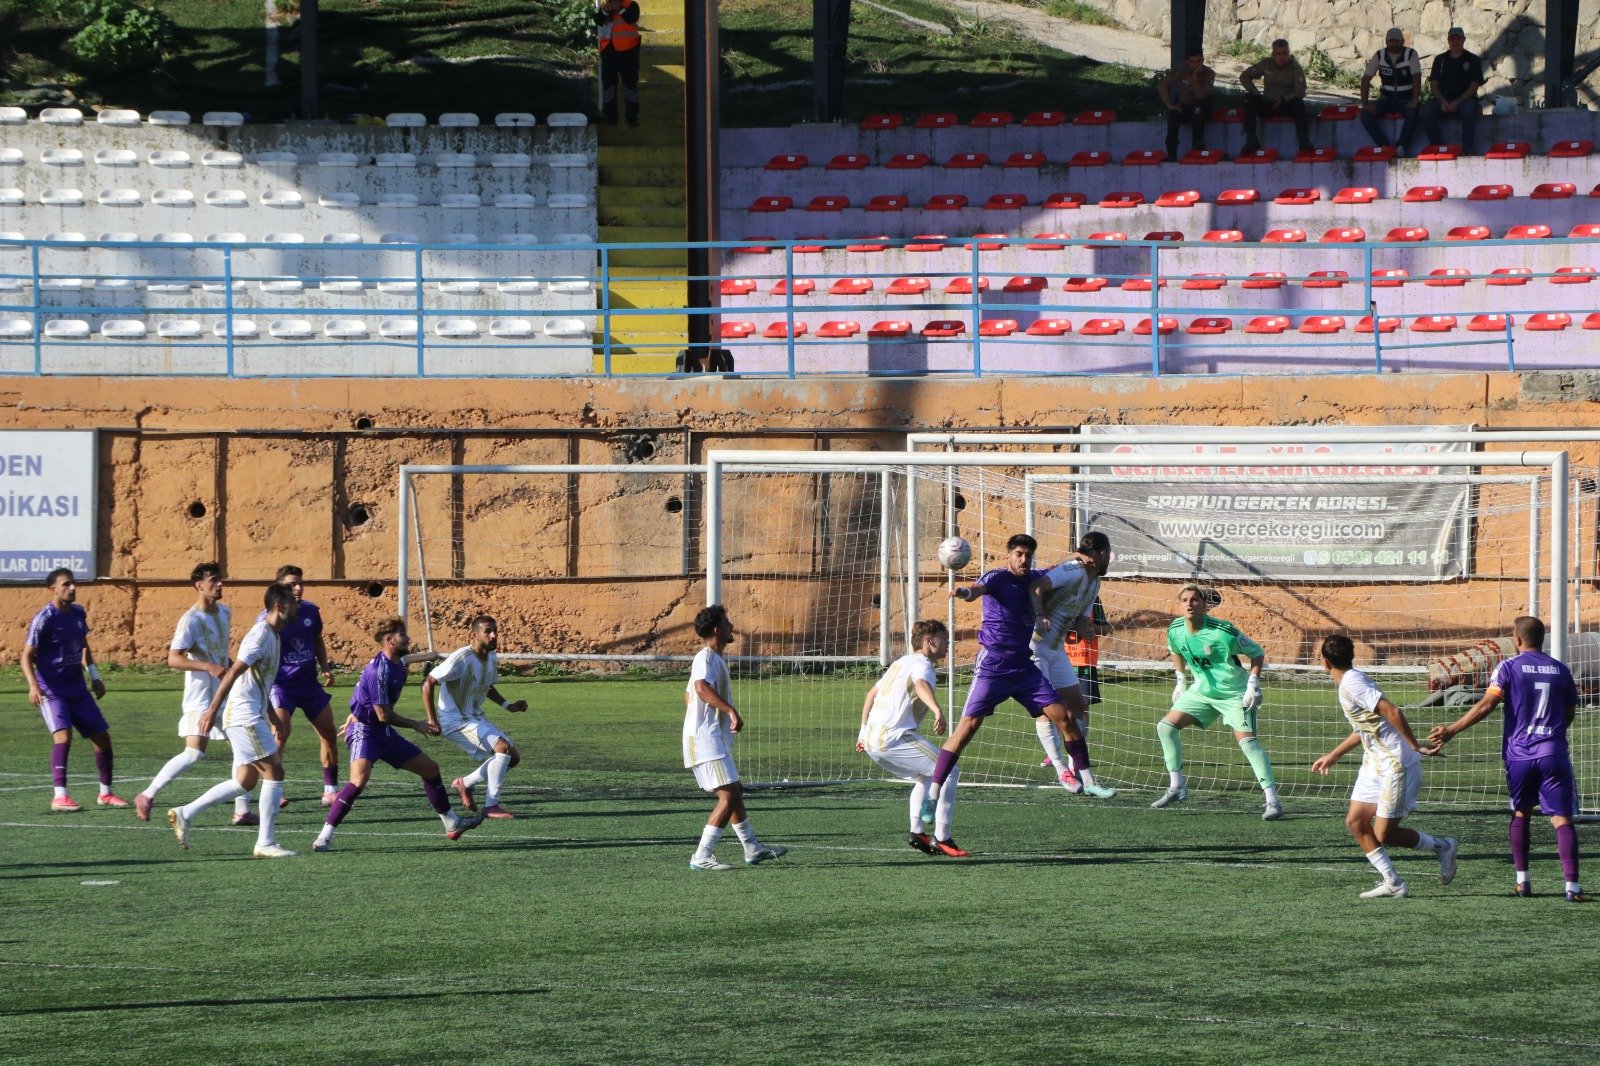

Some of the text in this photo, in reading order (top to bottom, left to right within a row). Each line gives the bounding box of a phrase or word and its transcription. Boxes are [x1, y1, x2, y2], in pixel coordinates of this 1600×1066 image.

[1160, 521, 1384, 540] www.gercekeregli.com
[1407, 550, 1426, 565] 11
[1534, 681, 1551, 719] 7
